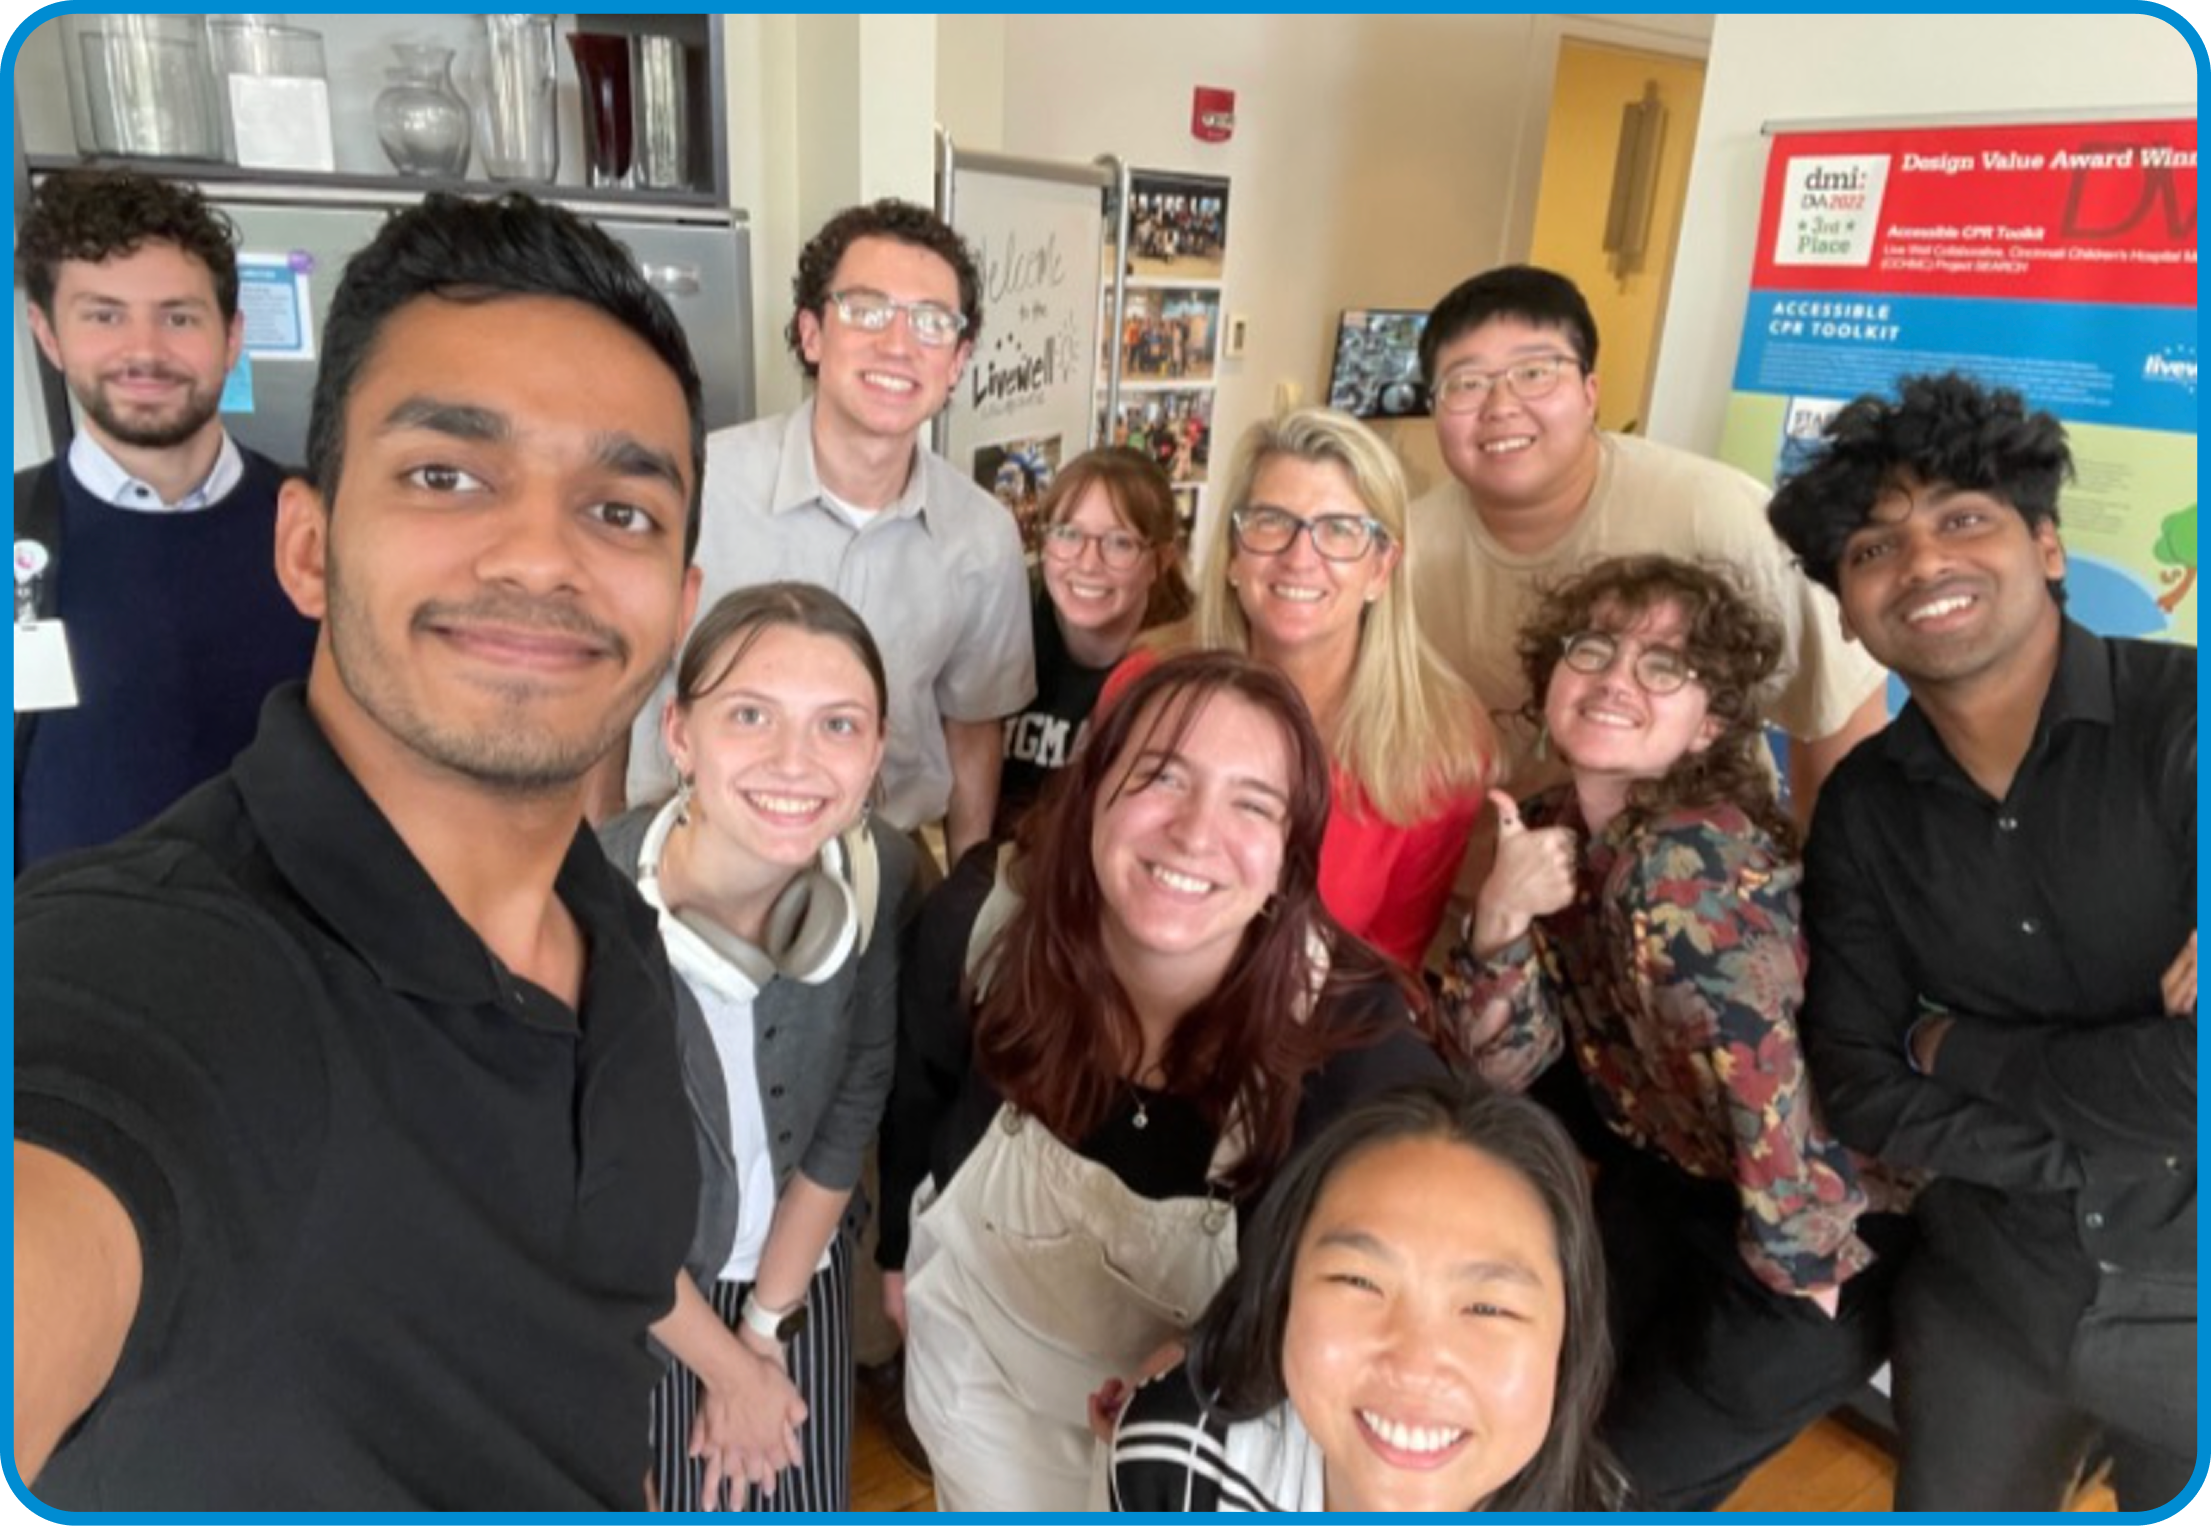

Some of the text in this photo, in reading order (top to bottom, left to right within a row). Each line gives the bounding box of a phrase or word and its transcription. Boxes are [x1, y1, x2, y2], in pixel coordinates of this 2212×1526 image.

[1902, 153, 1974, 175] Design
[1982, 151, 2044, 171] Value
[2050, 148, 2133, 169] Award
[1805, 166, 1866, 190] dmi:
[1812, 216, 1840, 235] 3rd
[1887, 225, 2044, 241] Accessible CPR Toolkit
[1798, 235, 1850, 254] Place
[1773, 301, 1890, 321] ACCESSIBLE
[1769, 319, 1900, 341] CPR TOOLKIT
[973, 336, 1054, 409] Livewell
